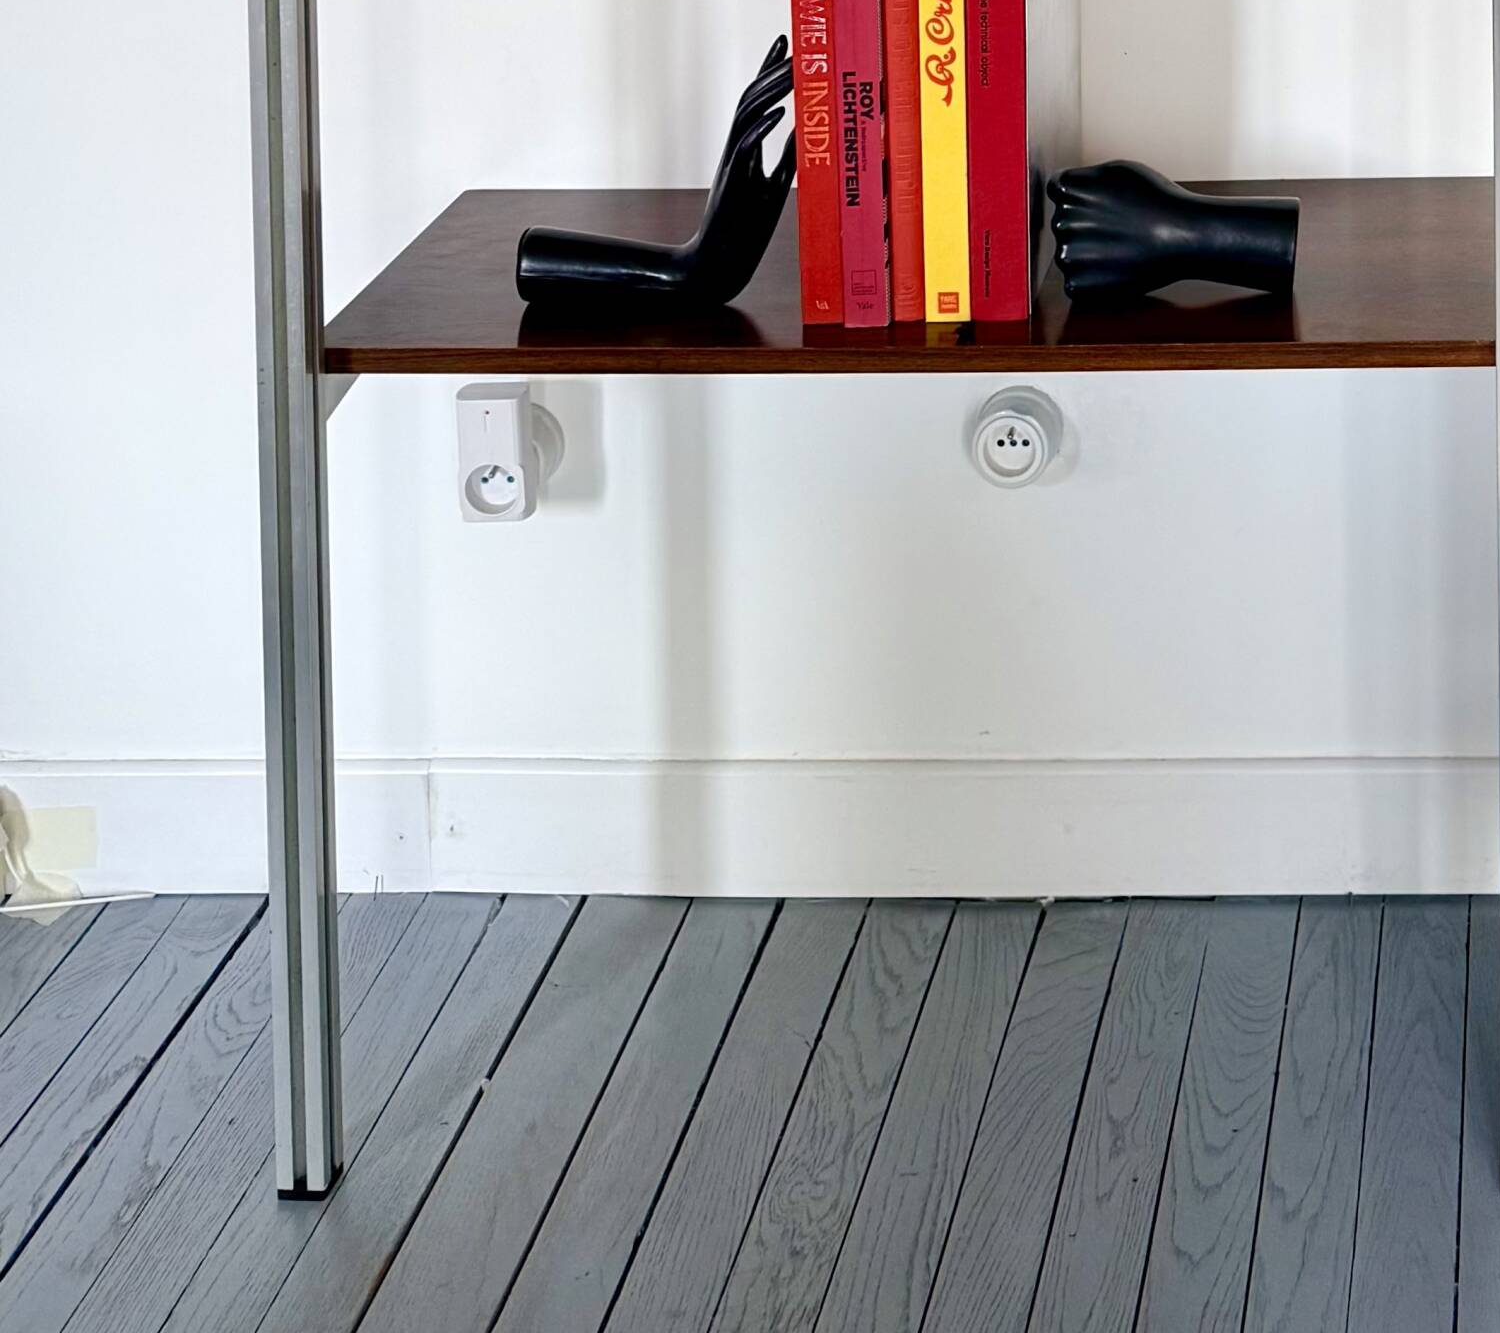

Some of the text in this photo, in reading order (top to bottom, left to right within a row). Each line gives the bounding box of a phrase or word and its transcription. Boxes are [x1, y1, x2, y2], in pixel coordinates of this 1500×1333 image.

[980, 12, 991, 53] technical
[801, 53, 827, 74] IS
[979, 57, 990, 86] object
[860, 81, 874, 120] ROY
[802, 81, 830, 167] INSIDE
[842, 71, 860, 206] LICHTENSTEIN
[857, 301, 875, 309] Yale
